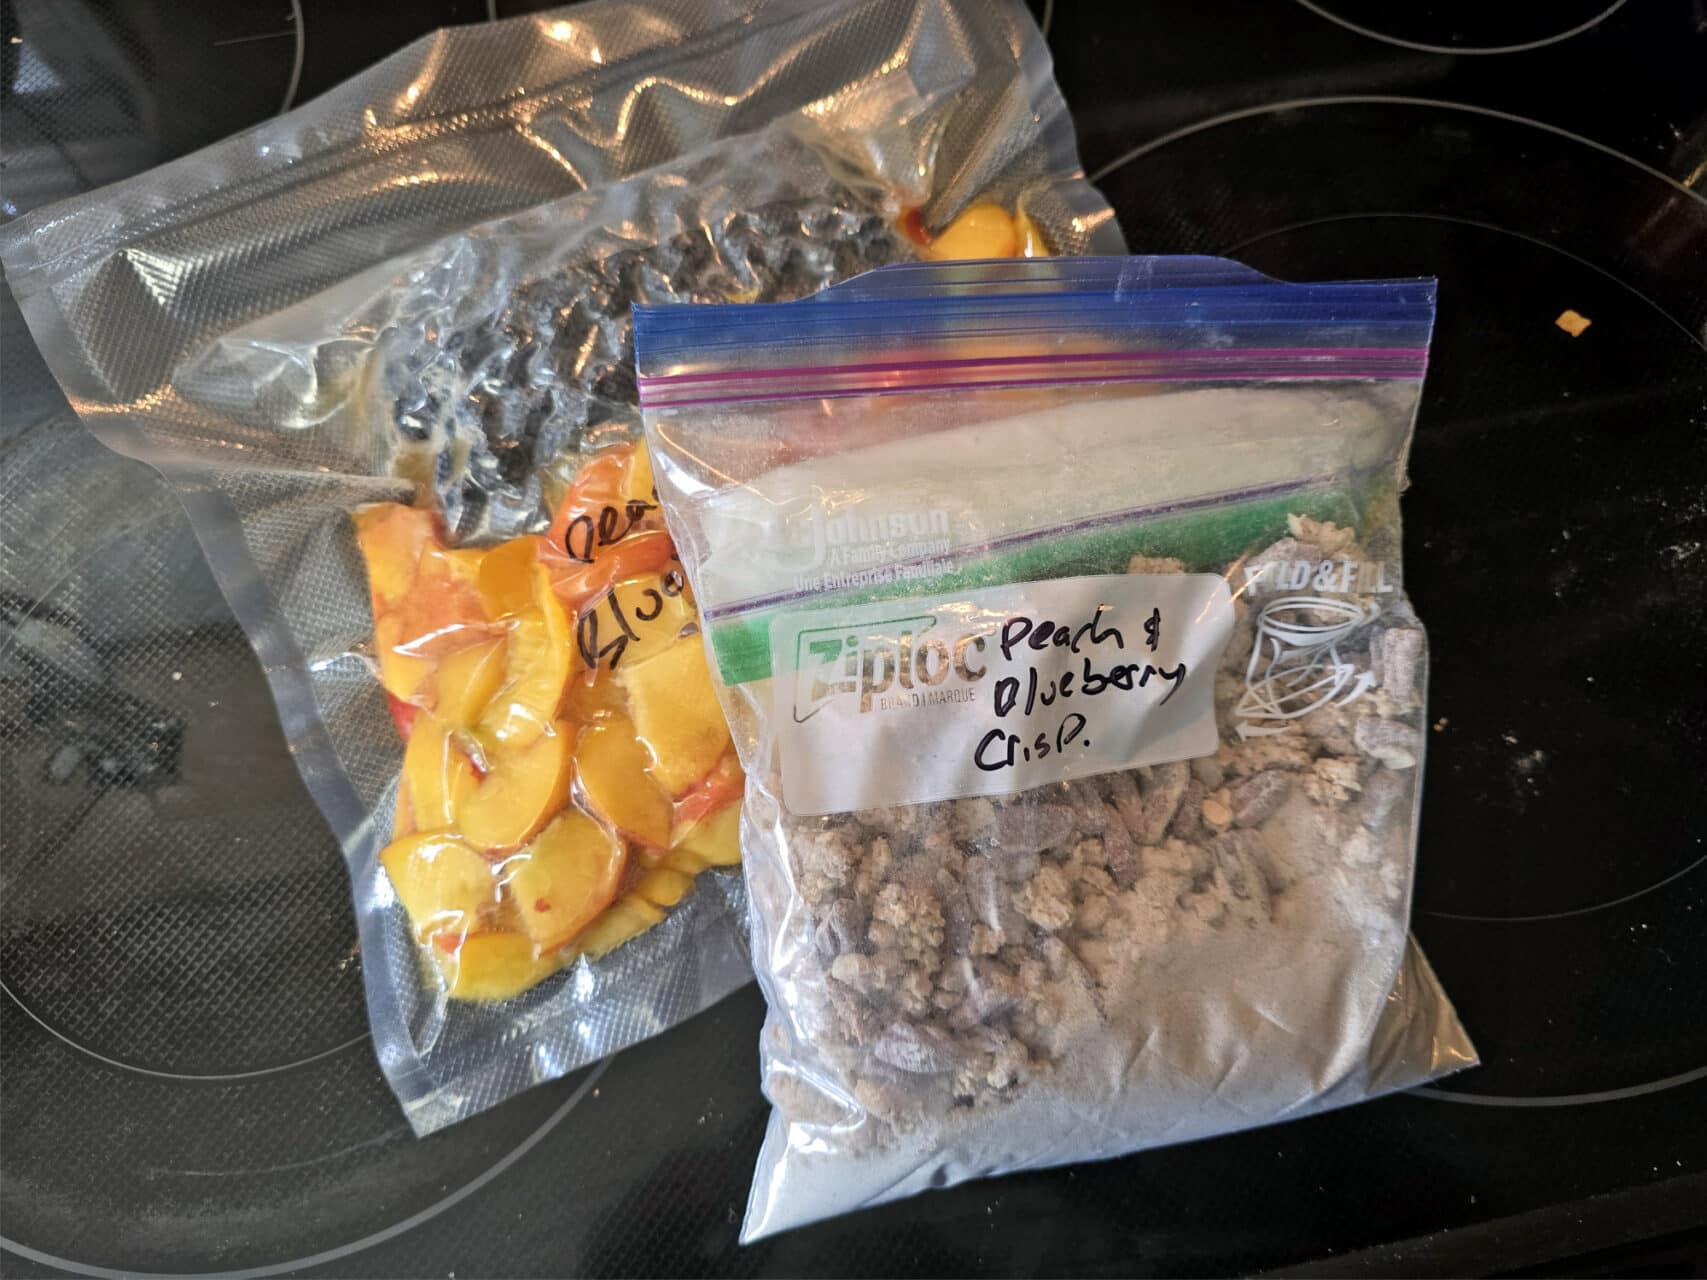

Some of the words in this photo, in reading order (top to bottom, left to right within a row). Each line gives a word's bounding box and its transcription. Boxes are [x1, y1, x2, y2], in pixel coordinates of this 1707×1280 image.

[1311, 559, 1339, 593] &
[577, 556, 685, 671] Blue
[1000, 603, 1125, 662] Peach
